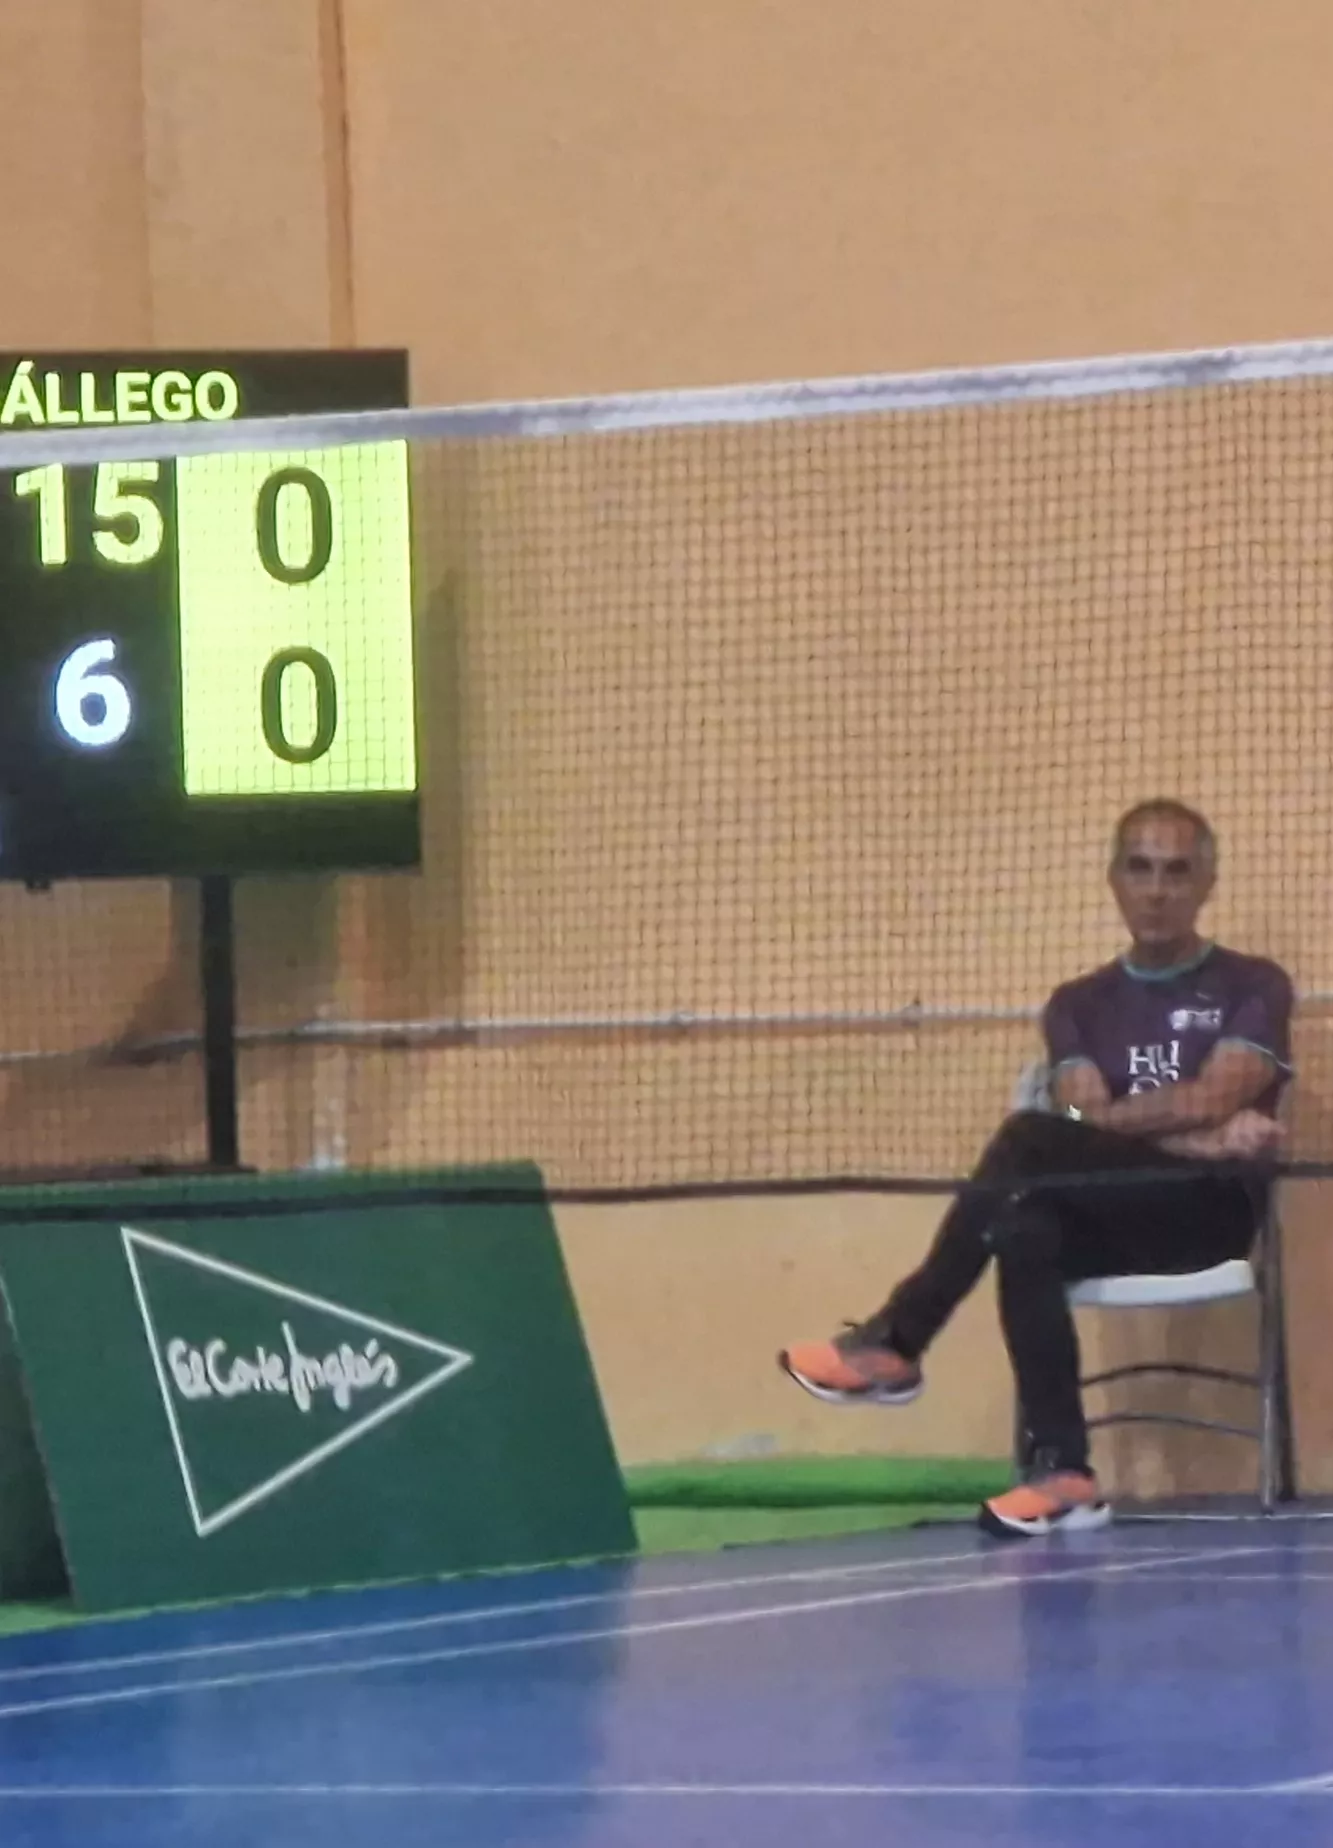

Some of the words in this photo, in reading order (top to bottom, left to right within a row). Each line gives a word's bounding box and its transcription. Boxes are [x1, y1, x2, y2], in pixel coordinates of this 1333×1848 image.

[1, 360, 238, 424] ÁLLEGO
[15, 461, 163, 566] 15
[256, 466, 333, 585] 0
[55, 638, 131, 747] 6
[261, 646, 338, 764] 0
[167, 1337, 213, 1400] El
[205, 1338, 290, 1397] Corte
